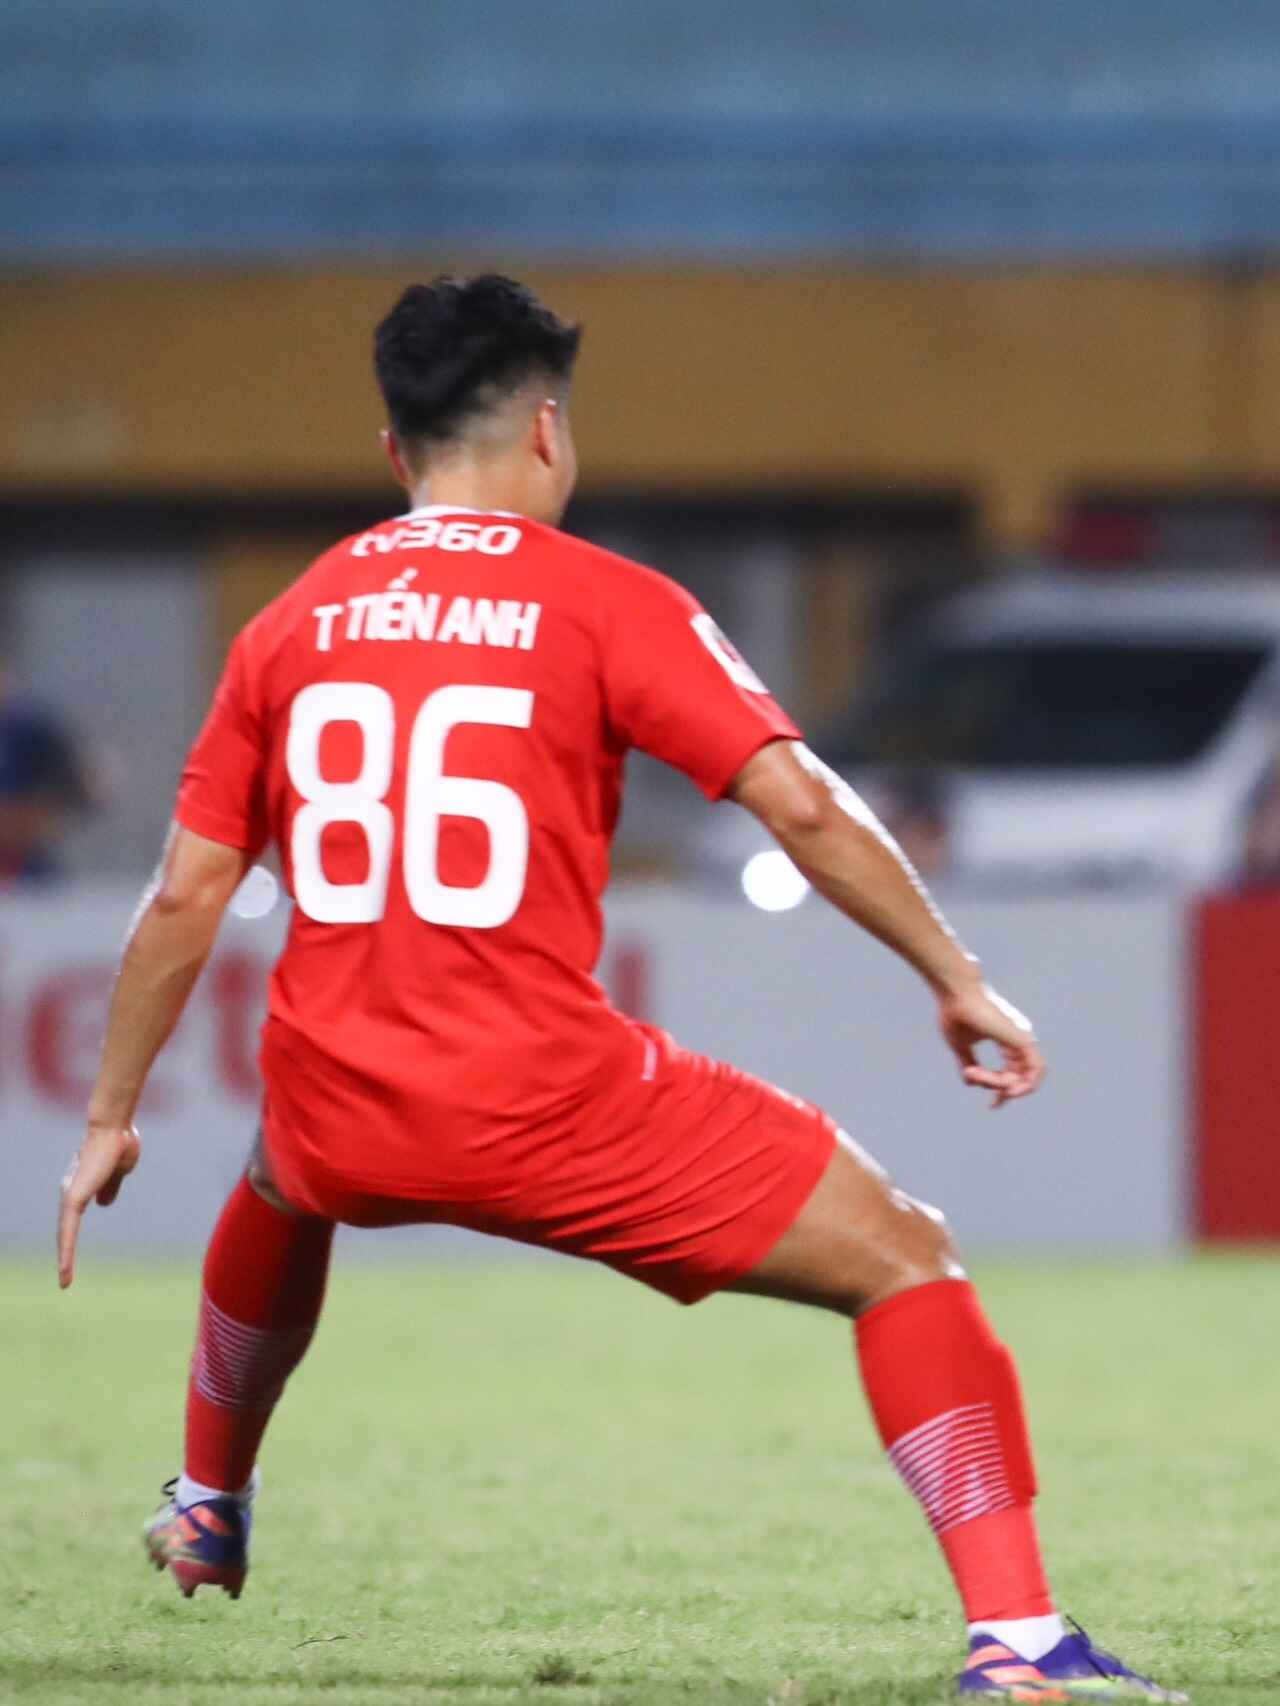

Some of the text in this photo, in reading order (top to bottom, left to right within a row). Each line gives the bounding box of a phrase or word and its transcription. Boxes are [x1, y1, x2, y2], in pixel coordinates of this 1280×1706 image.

[312, 604, 344, 652] T
[435, 595, 543, 651] ANH
[284, 681, 536, 930] 86
